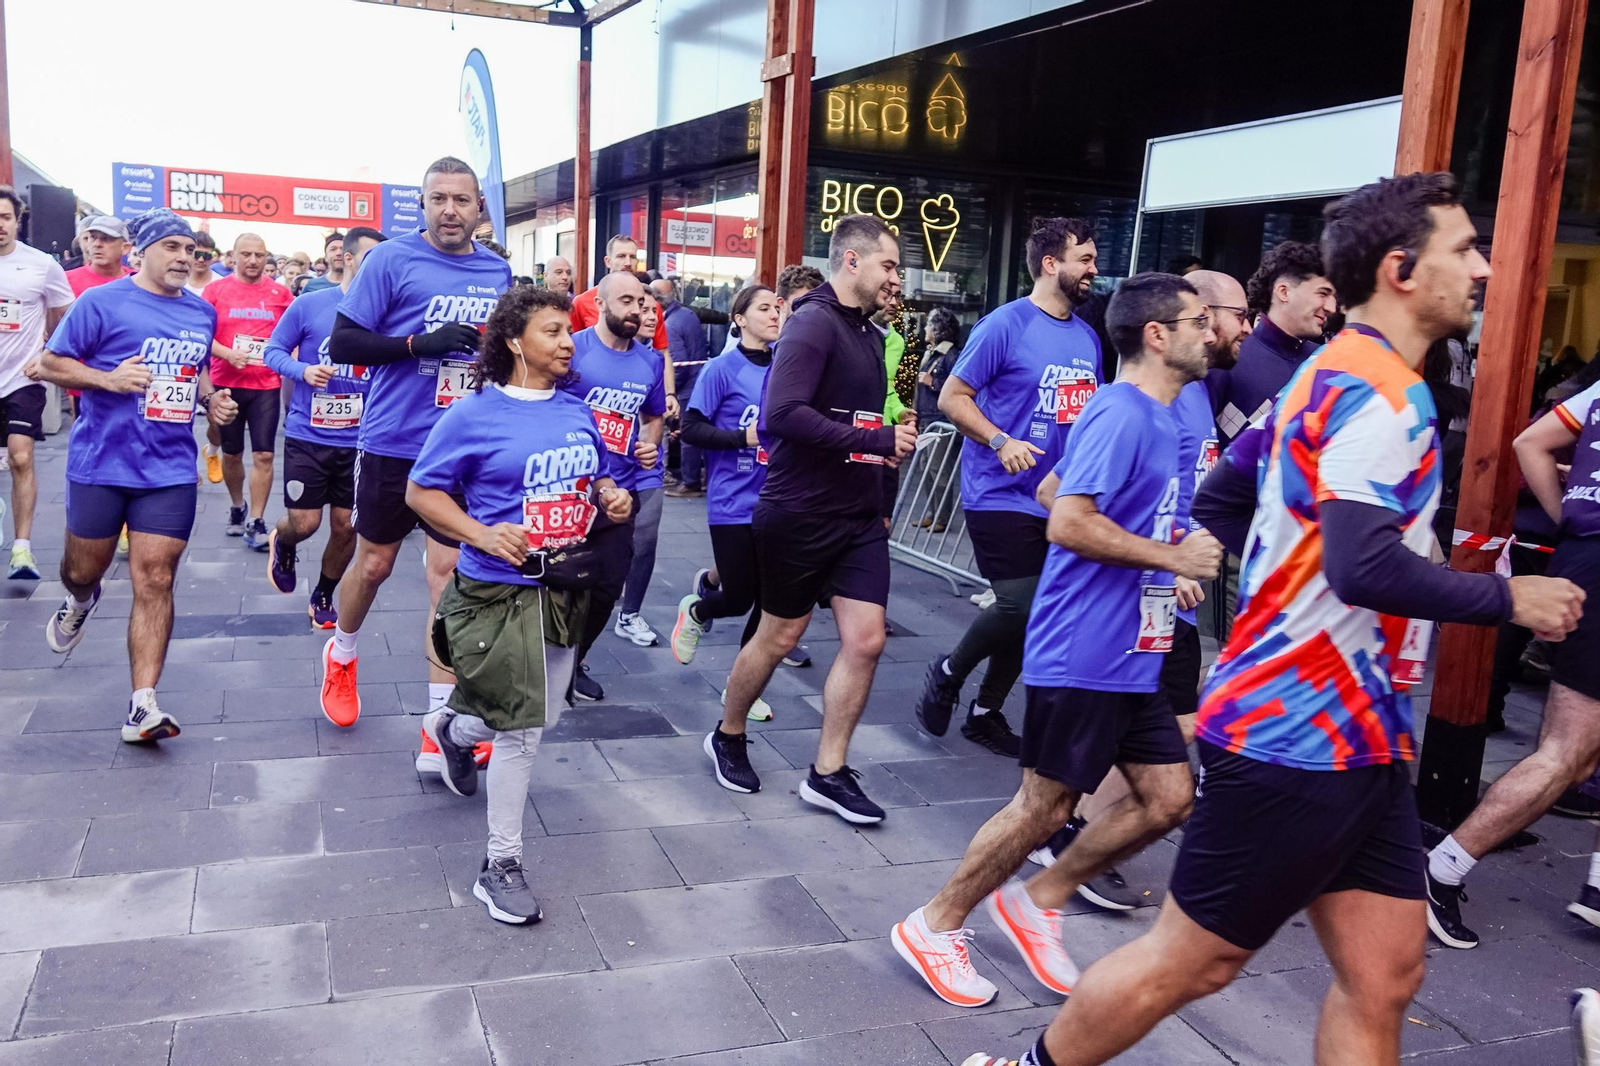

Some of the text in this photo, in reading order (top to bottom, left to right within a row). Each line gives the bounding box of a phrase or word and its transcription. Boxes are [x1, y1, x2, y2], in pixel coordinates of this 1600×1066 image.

[169, 170, 224, 195] RUN
[298, 193, 345, 203] CONCELLO
[821, 179, 904, 220] BICO
[318, 204, 340, 212] VIGO
[1, 306, 8, 318] 5
[165, 385, 192, 404] 254
[326, 402, 352, 415] 235
[598, 418, 624, 439] 598
